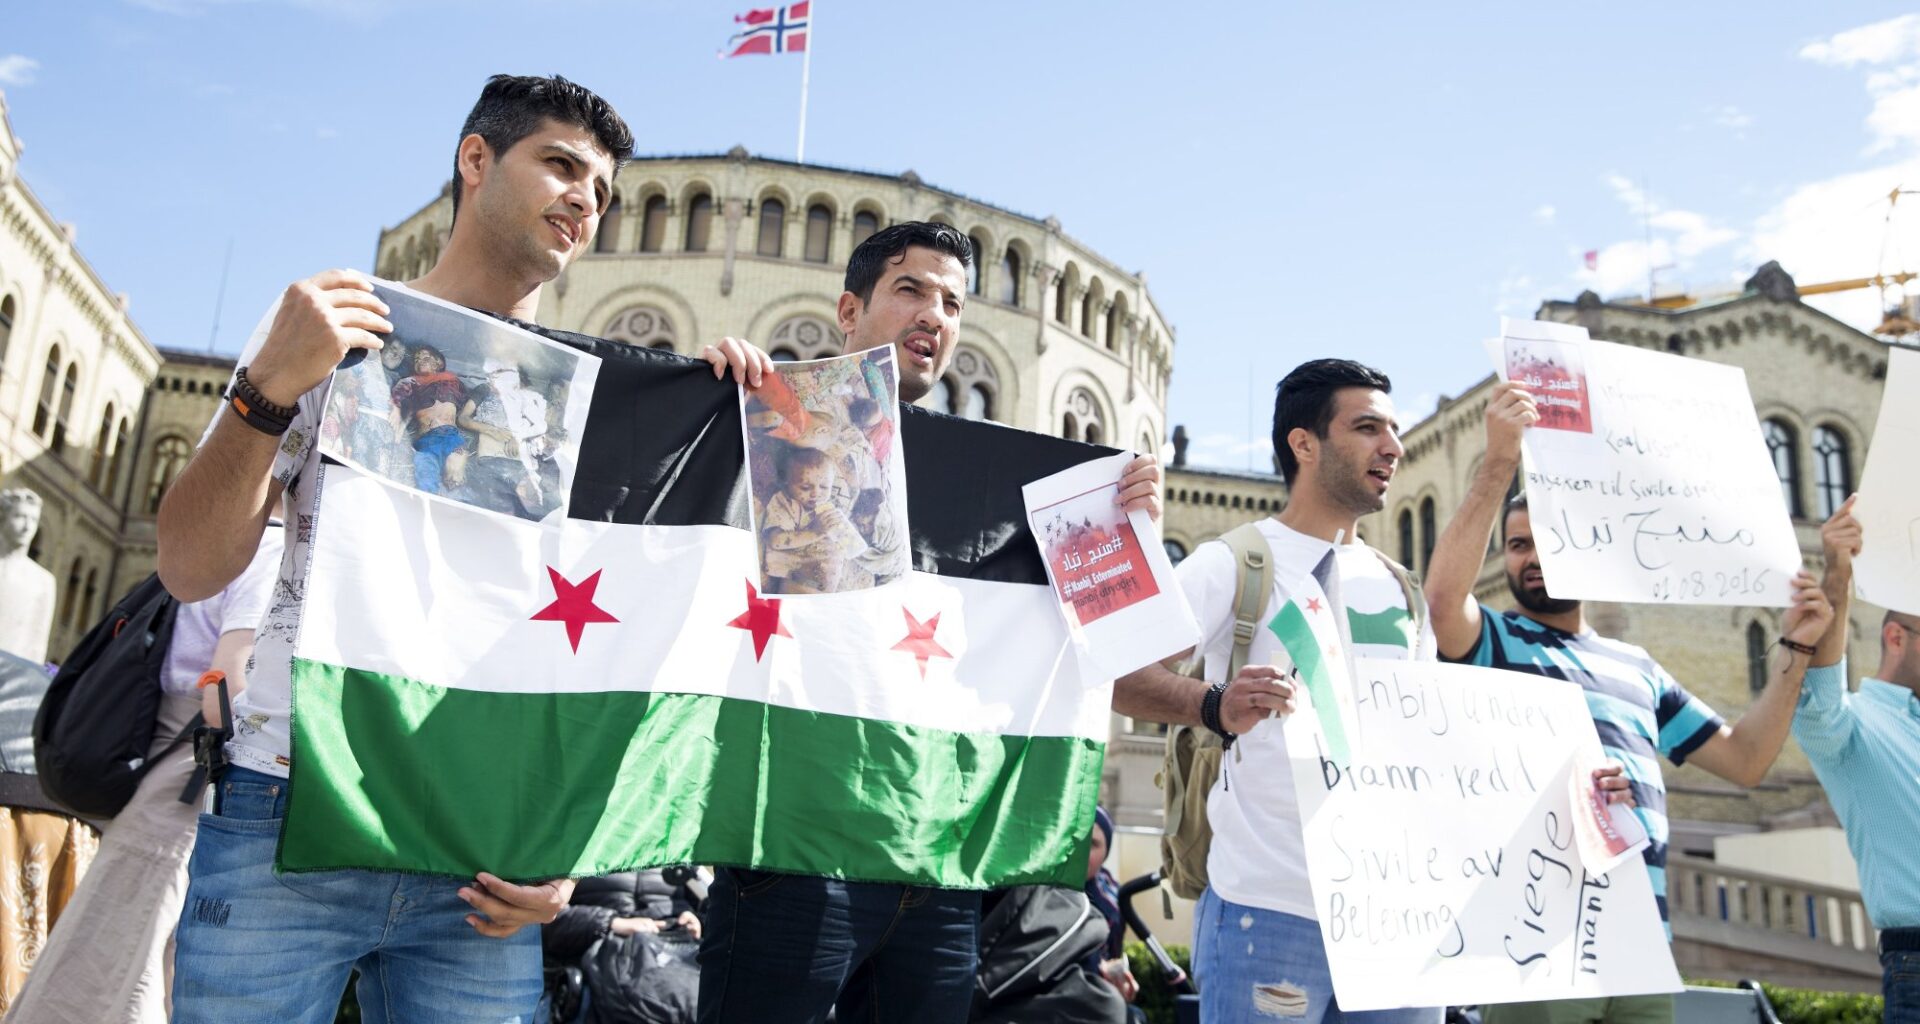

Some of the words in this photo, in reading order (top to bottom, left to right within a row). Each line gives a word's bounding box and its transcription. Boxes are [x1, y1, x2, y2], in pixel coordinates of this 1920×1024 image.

[1622, 507, 1756, 571] منبج
[1358, 672, 1448, 736] nbij
[1462, 687, 1556, 737] under
[1461, 846, 1503, 879] av
[1504, 809, 1575, 977] Siege
